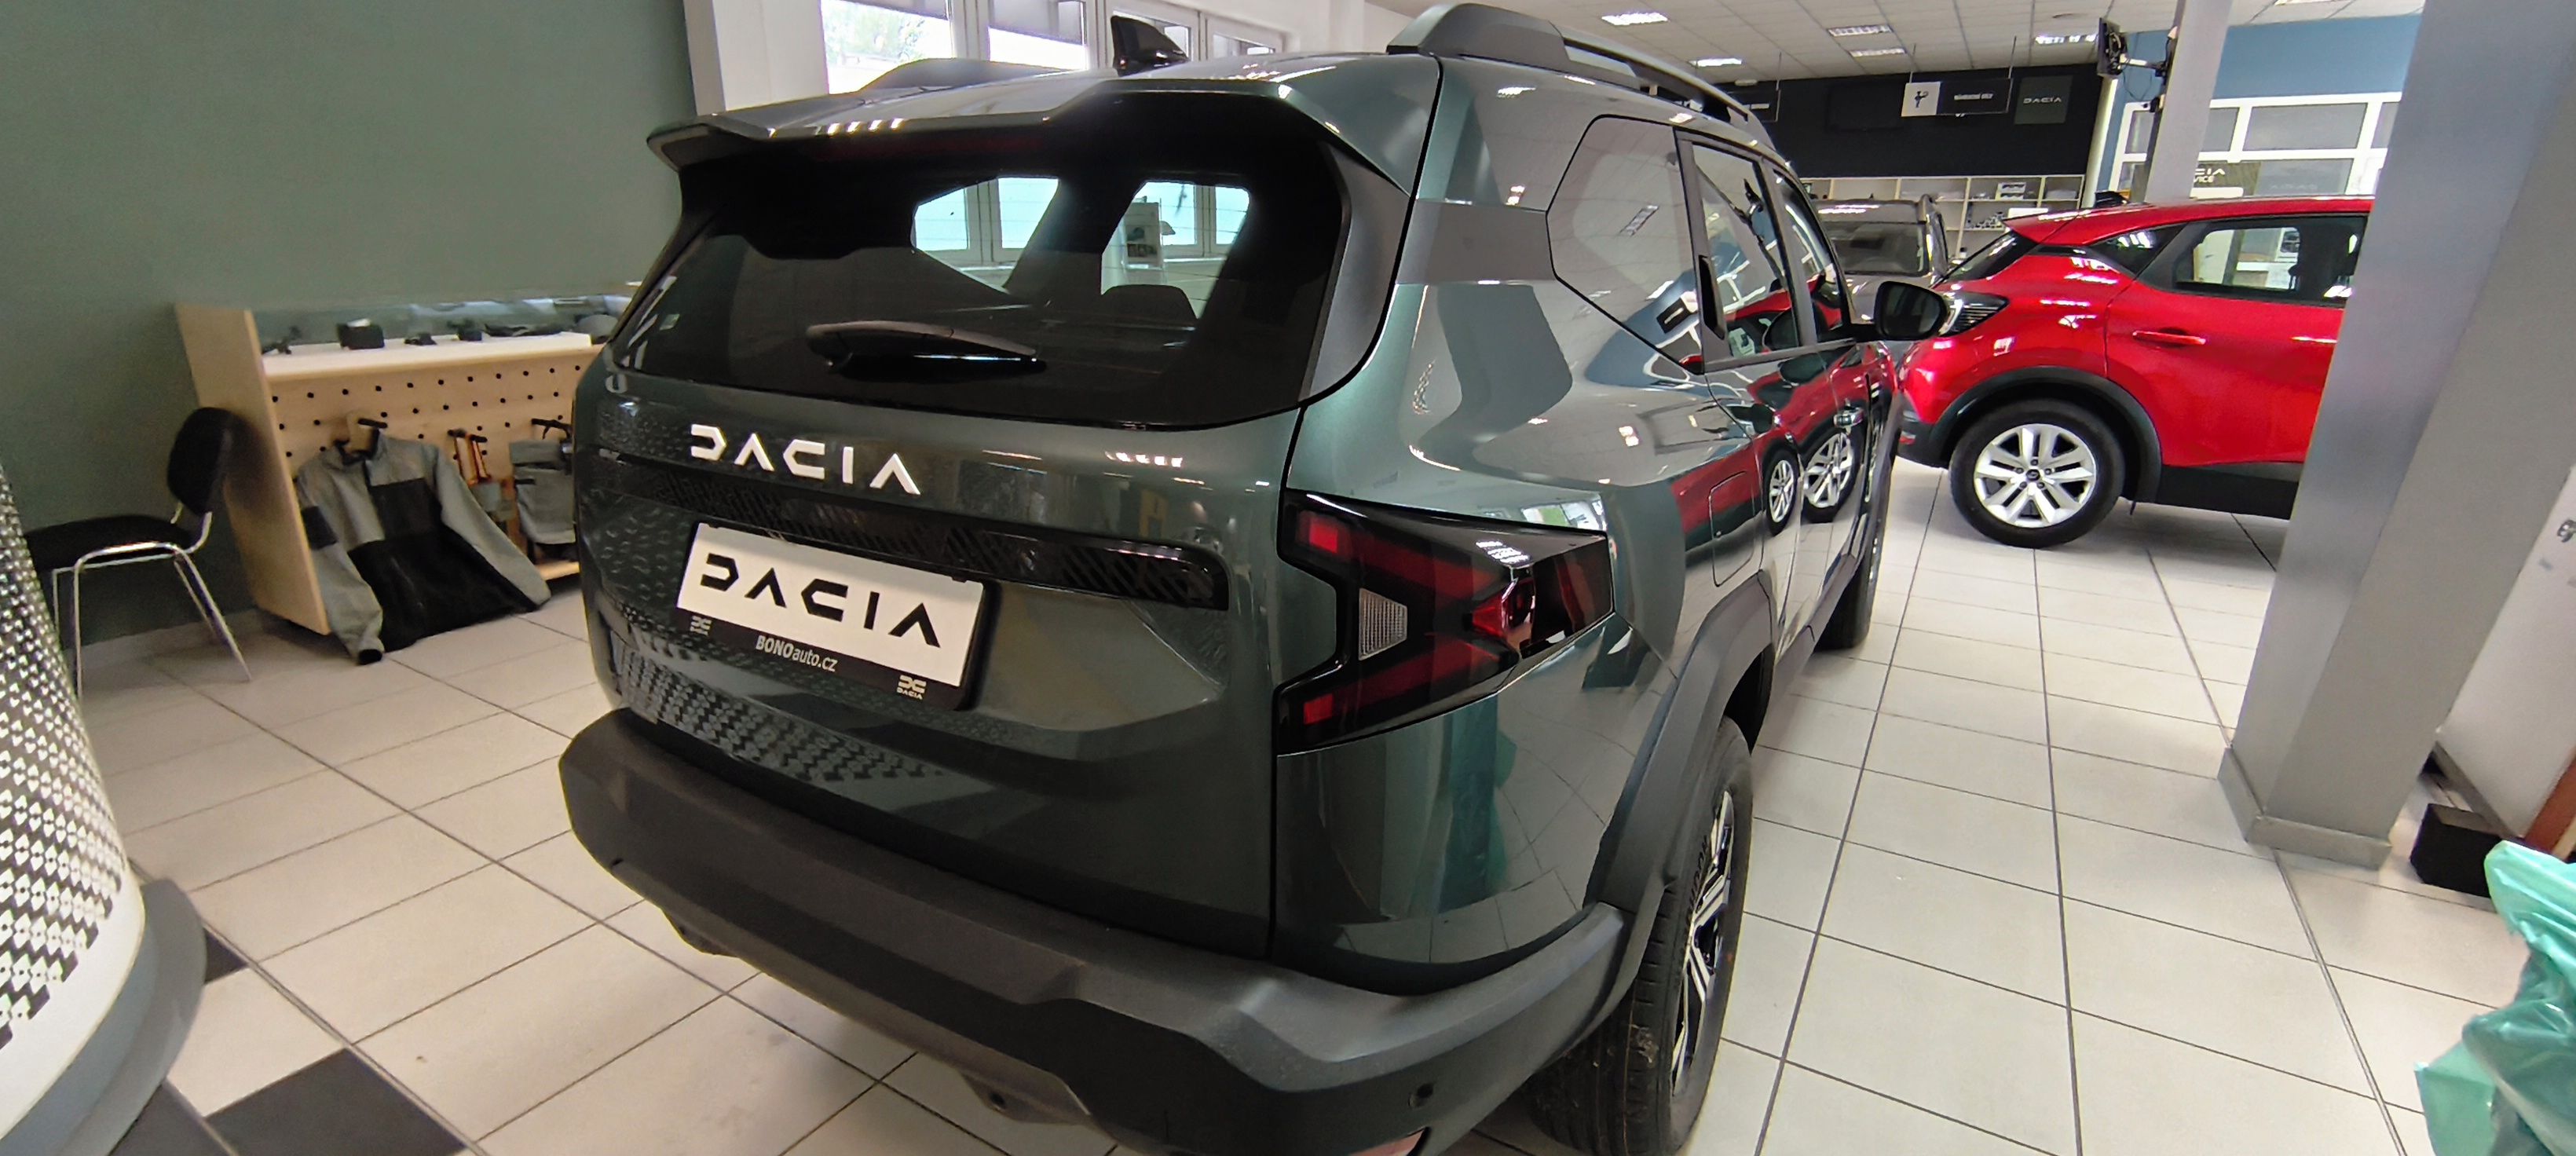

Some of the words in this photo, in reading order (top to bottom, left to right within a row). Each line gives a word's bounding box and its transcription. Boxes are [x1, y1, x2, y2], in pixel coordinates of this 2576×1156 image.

[690, 423, 921, 496] DACIA
[700, 552, 941, 649] DACIA
[756, 635, 838, 672] BONOauto.cz
[896, 686, 923, 700] DACIA
